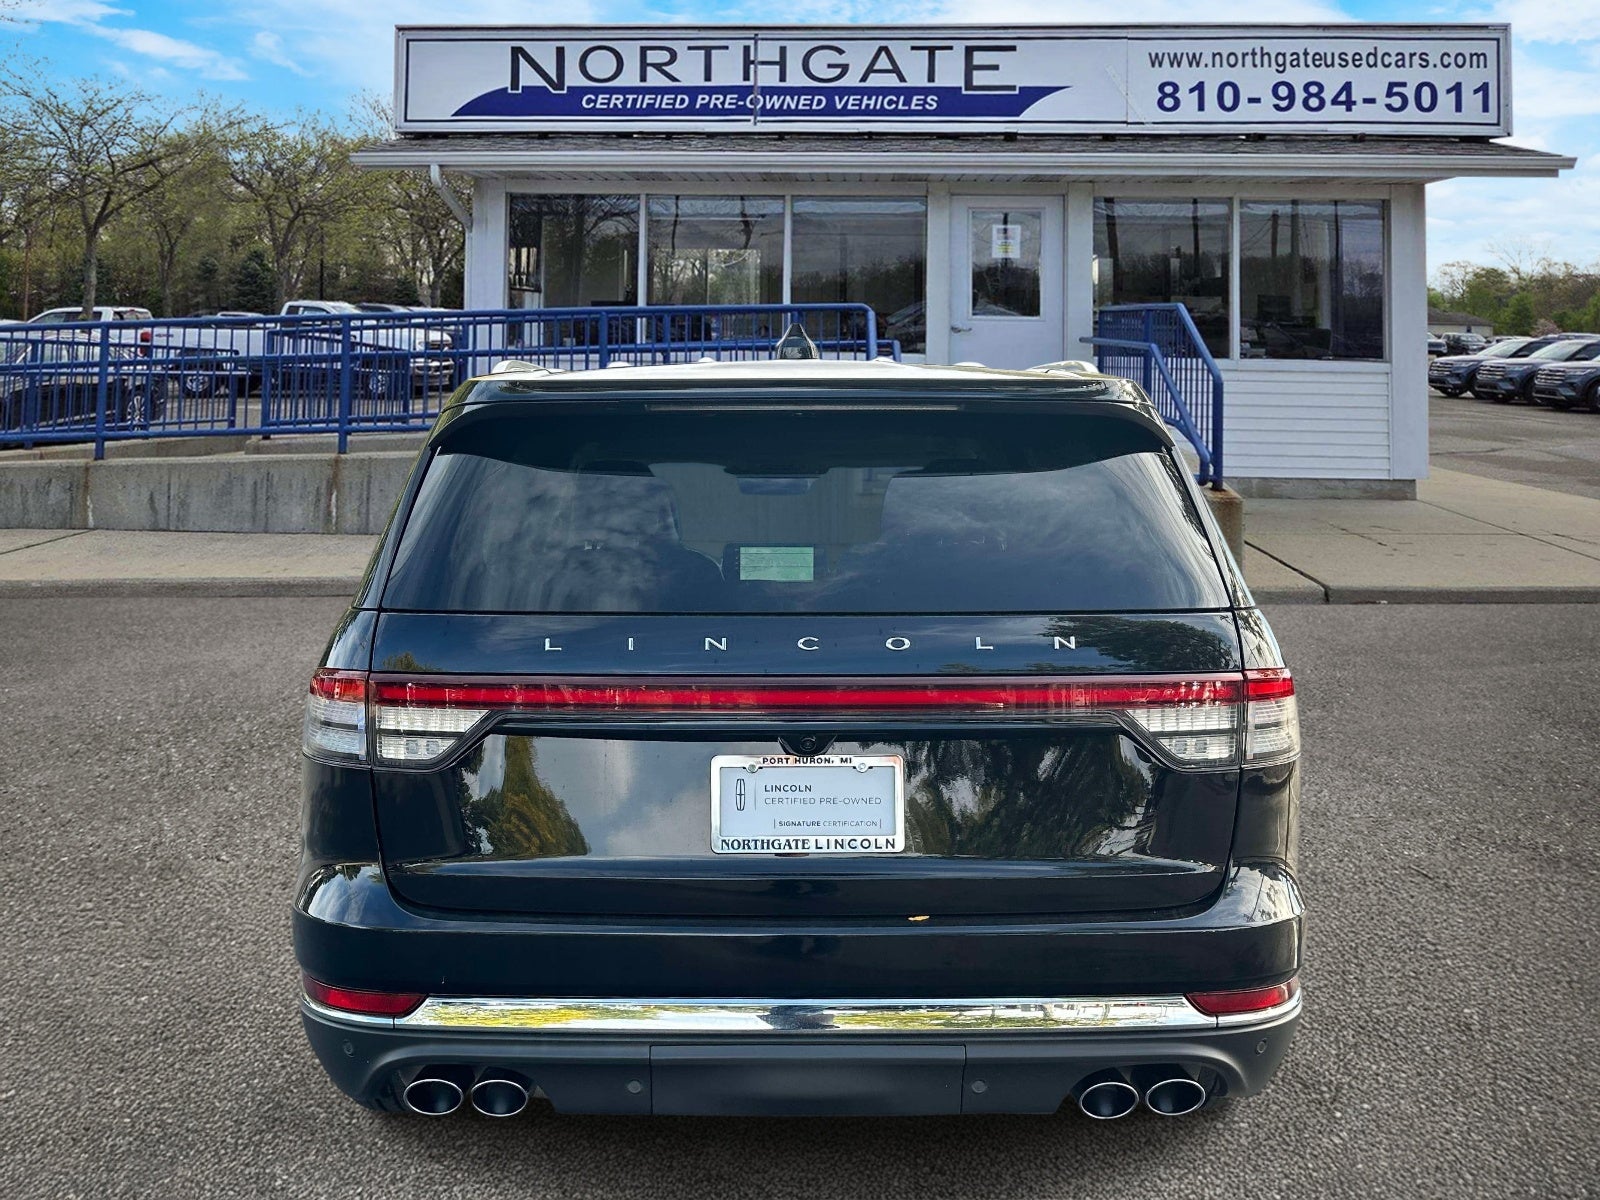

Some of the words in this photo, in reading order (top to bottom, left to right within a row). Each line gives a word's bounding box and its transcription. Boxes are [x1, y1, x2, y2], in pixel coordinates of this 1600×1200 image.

[1149, 46, 1488, 73] www.northgateusedcars.com
[509, 44, 1017, 93] NORTHGATE
[581, 94, 689, 111] CERTIFIED
[695, 94, 827, 112] PRE-OWNED
[833, 95, 938, 112] VEHICLES
[1156, 80, 1490, 113] 810-984-5011
[544, 636, 1076, 651] LINCOLN
[762, 757, 791, 765] PORT
[764, 784, 812, 793] LINCOLN
[764, 797, 815, 805] CERTIFIED
[819, 797, 882, 805] PRE-OWNED
[720, 838, 810, 850] NORTHGATE
[815, 838, 896, 850] LINCOLN
